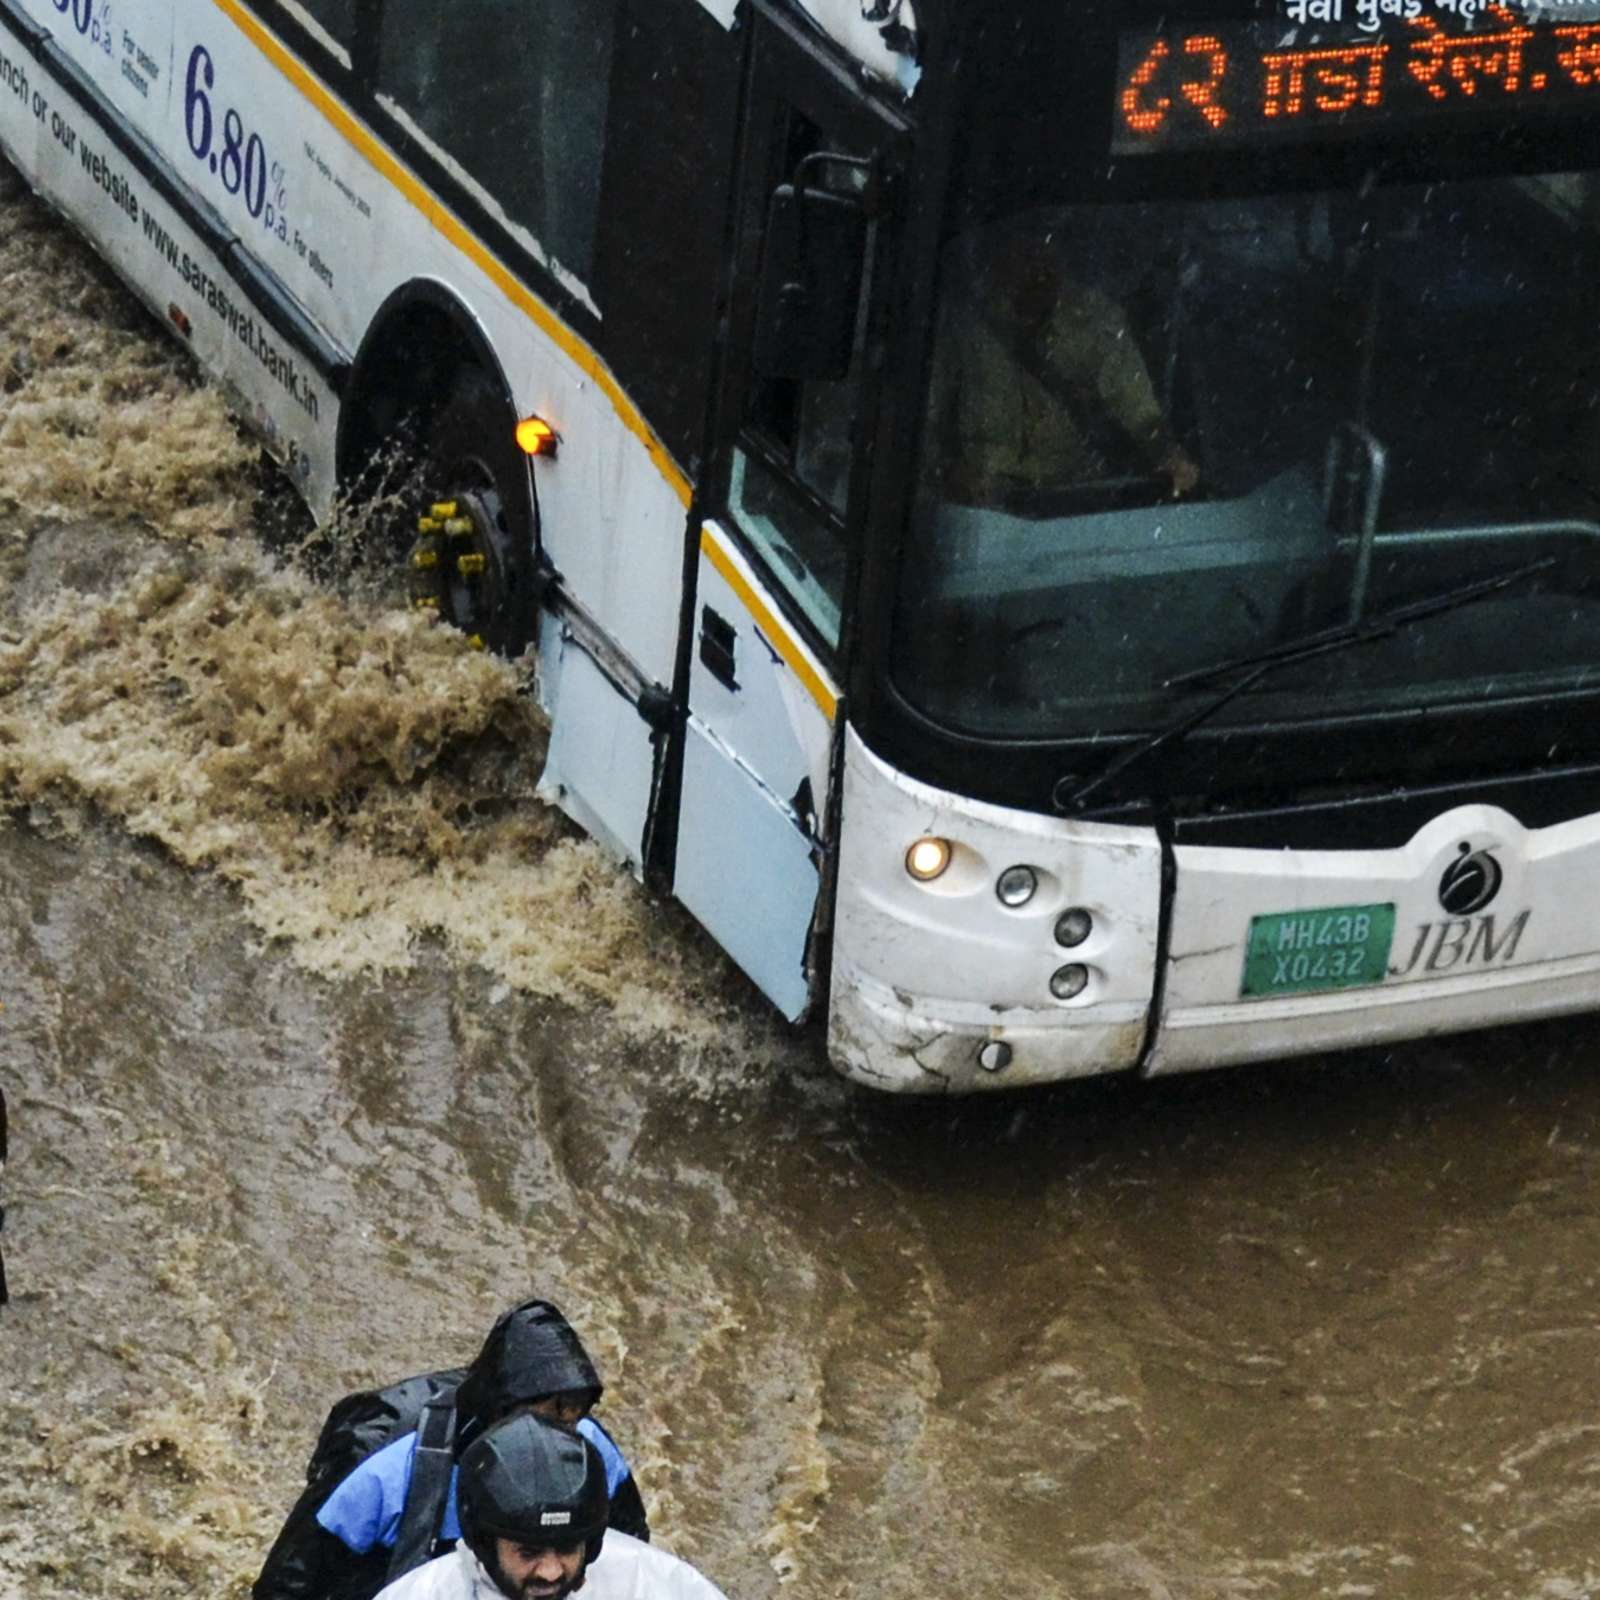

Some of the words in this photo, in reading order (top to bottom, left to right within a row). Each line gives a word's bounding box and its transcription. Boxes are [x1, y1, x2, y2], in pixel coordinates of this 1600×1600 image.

[32, 88, 48, 123] or
[52, 112, 78, 155] our
[79, 139, 139, 223] website
[185, 44, 267, 219] 6.80
[1277, 914, 1371, 952] MH43B
[1388, 910, 1532, 976] JBM
